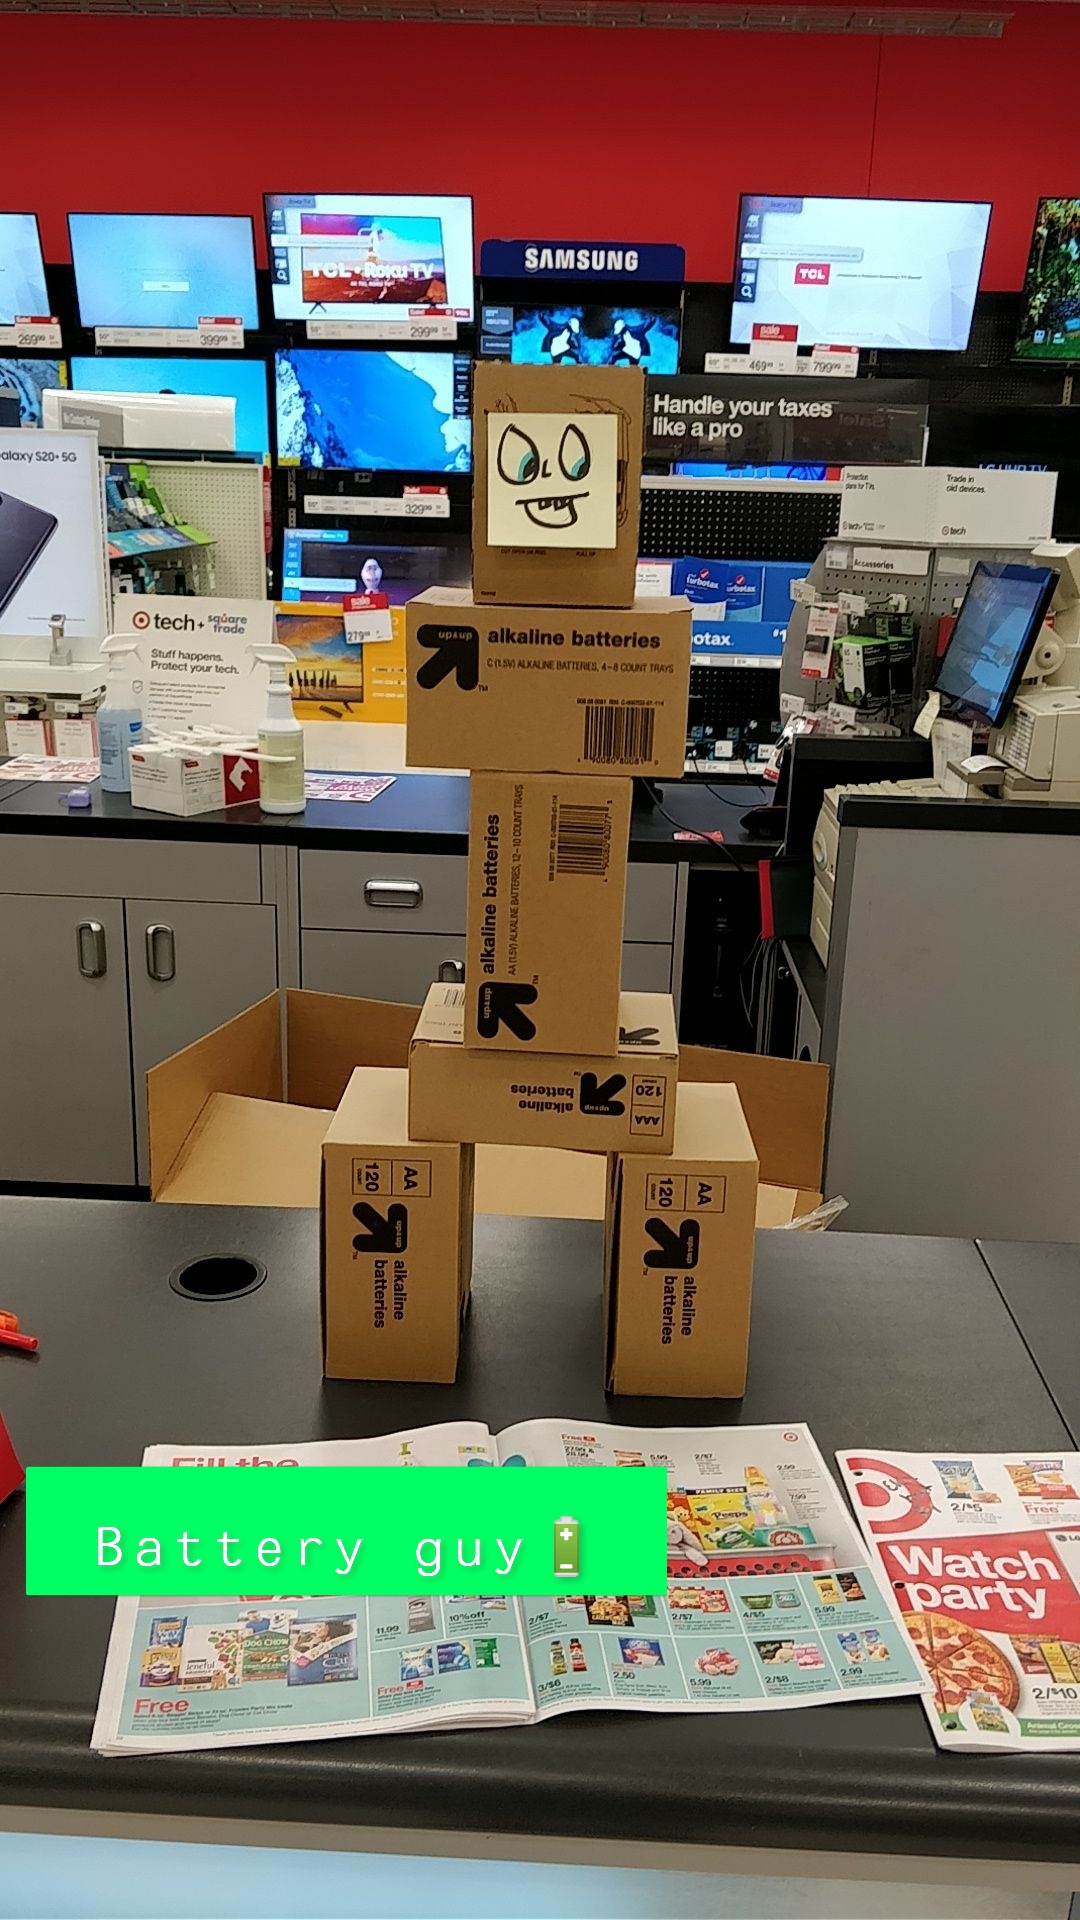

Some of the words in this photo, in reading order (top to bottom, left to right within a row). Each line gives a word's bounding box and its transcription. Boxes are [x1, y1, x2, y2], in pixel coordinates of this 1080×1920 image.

[525, 247, 639, 272] SAMSUNG
[309, 262, 352, 279] TCL
[364, 262, 408, 280] Roku
[409, 263, 435, 280] TV
[799, 268, 826, 281] TCL
[760, 324, 781, 336] sale
[654, 393, 724, 415] Handle
[728, 400, 774, 419] your
[778, 398, 833, 418] taxes
[653, 416, 686, 437] like
[690, 422, 705, 437] a
[708, 422, 743, 441] pro
[0, 451, 33, 464] alaxy
[35, 451, 60, 463] S20+
[61, 452, 77, 463] 5G
[947, 474, 967, 483] Trade
[968, 475, 975, 483] in
[946, 485, 958, 493] old
[959, 485, 986, 494] devices.
[950, 526, 966, 536] tech
[853, 559, 894, 570] Accessories
[726, 584, 756, 593] urbotax
[350, 598, 371, 609] sale
[154, 613, 195, 631] tech
[208, 613, 248, 626] square
[213, 624, 245, 635] trade
[487, 628, 565, 646] alkaline
[571, 630, 661, 649] batteries
[772, 629, 786, 642] #1
[151, 648, 177, 659] Stuff
[178, 649, 223, 662] happens.
[151, 660, 188, 671] Protect
[190, 662, 213, 674] your
[215, 664, 240, 675] tech.
[487, 657, 494, 668] C
[516, 658, 554, 671] ALKALINE
[556, 659, 599, 673] BATTERIES,
[620, 663, 647, 674] COUNT
[649, 663, 674, 674] TRAYS
[478, 684, 489, 692] TM
[513, 784, 524, 808] TRAYS
[512, 809, 523, 837] COUNT
[482, 813, 500, 898] batteries
[510, 864, 522, 905] BATTERIES,
[509, 905, 520, 942] ALKALINE
[480, 903, 497, 975] alkaline
[508, 964, 517, 976] AA
[510, 1084, 574, 1099] batteries
[635, 1085, 663, 1097] 120
[518, 1099, 574, 1113] alkaline
[634, 1115, 661, 1126] AAA
[365, 1162, 380, 1192] 120
[403, 1166, 418, 1191] AA
[658, 1177, 673, 1208] 120
[697, 1182, 712, 1206] AA
[374, 1259, 388, 1329] batteries
[393, 1260, 408, 1321] alkaline
[661, 1275, 678, 1345] batteries
[680, 1276, 697, 1336] alkaline
[887, 1544, 1061, 1582] Watch
[906, 1580, 1047, 1620] party
[376, 1625, 400, 1635] 11.99
[377, 1684, 404, 1695] Free
[1031, 1687, 1078, 1700] 2/$10
[134, 1698, 190, 1714] Free
